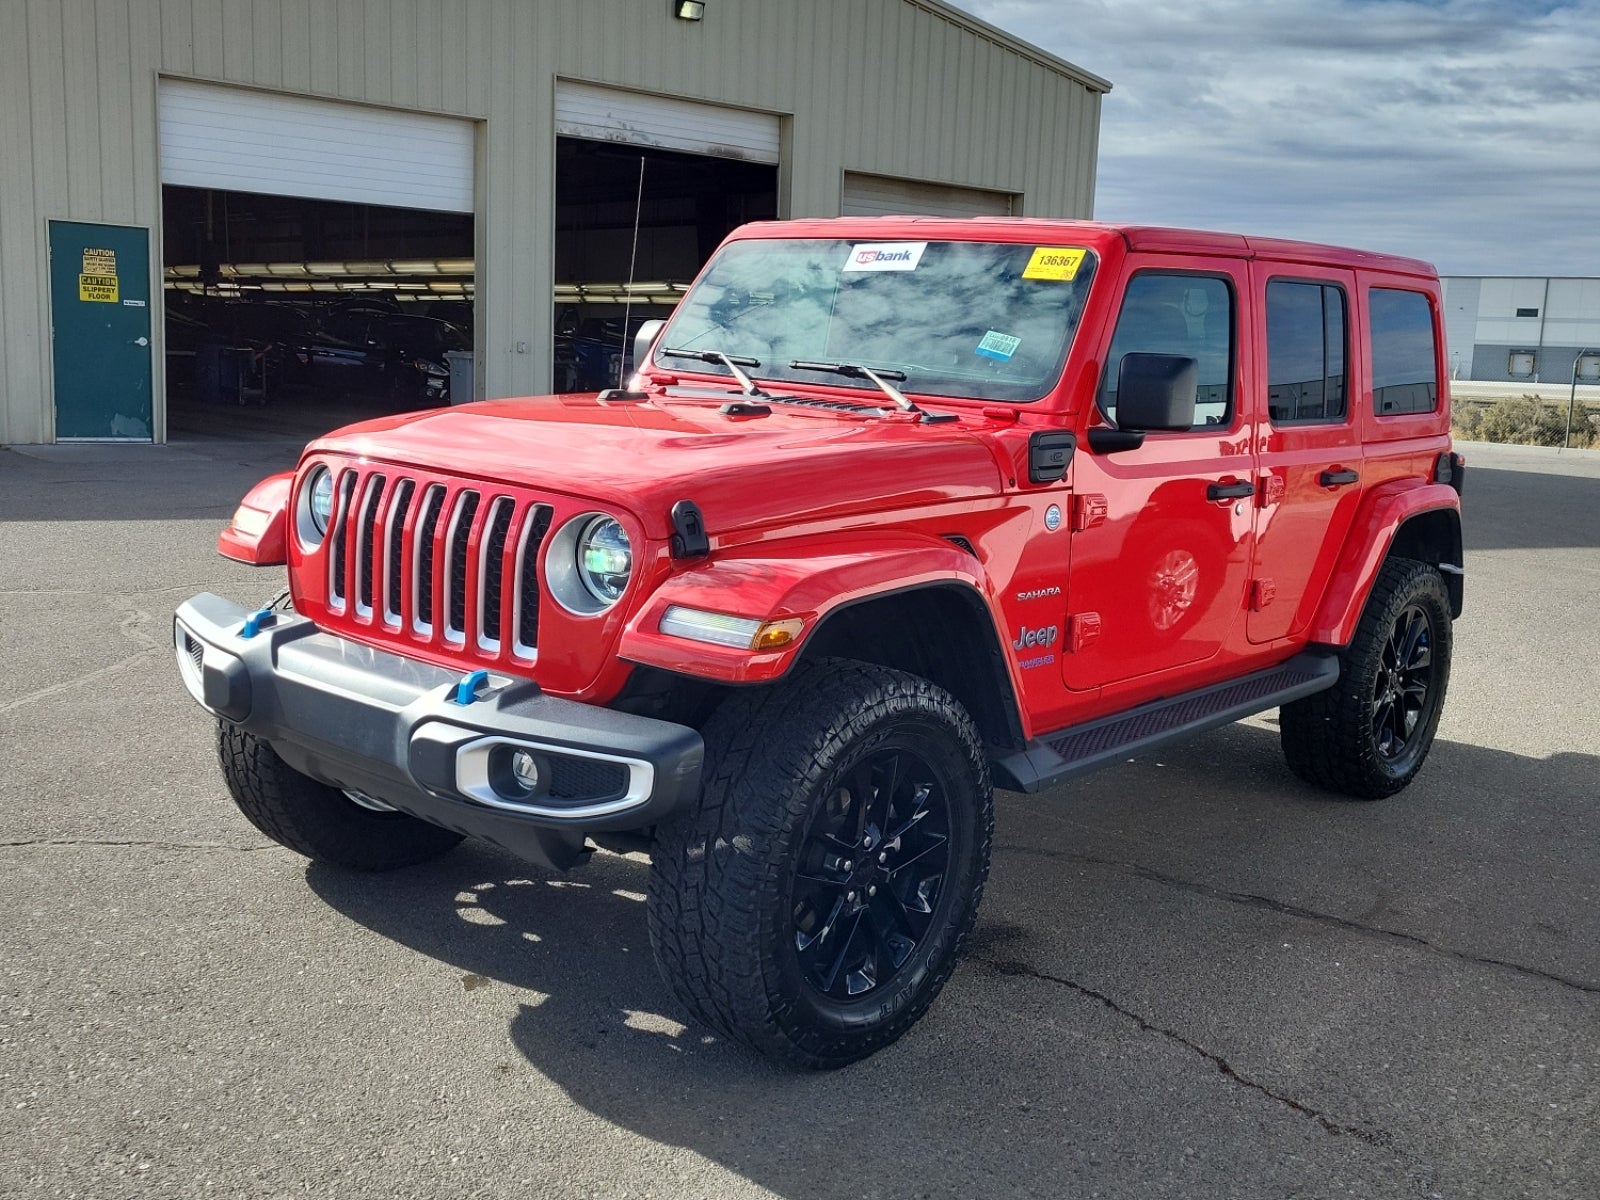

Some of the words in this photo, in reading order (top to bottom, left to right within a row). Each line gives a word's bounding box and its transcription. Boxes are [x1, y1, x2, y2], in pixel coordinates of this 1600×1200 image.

[83, 248, 115, 257] CAUTION
[1039, 255, 1079, 267] 136367
[81, 277, 116, 286] CAUTION
[82, 286, 116, 294] SLIPPERY
[1016, 586, 1062, 601] SAHARA
[1012, 624, 1058, 651] Jeep
